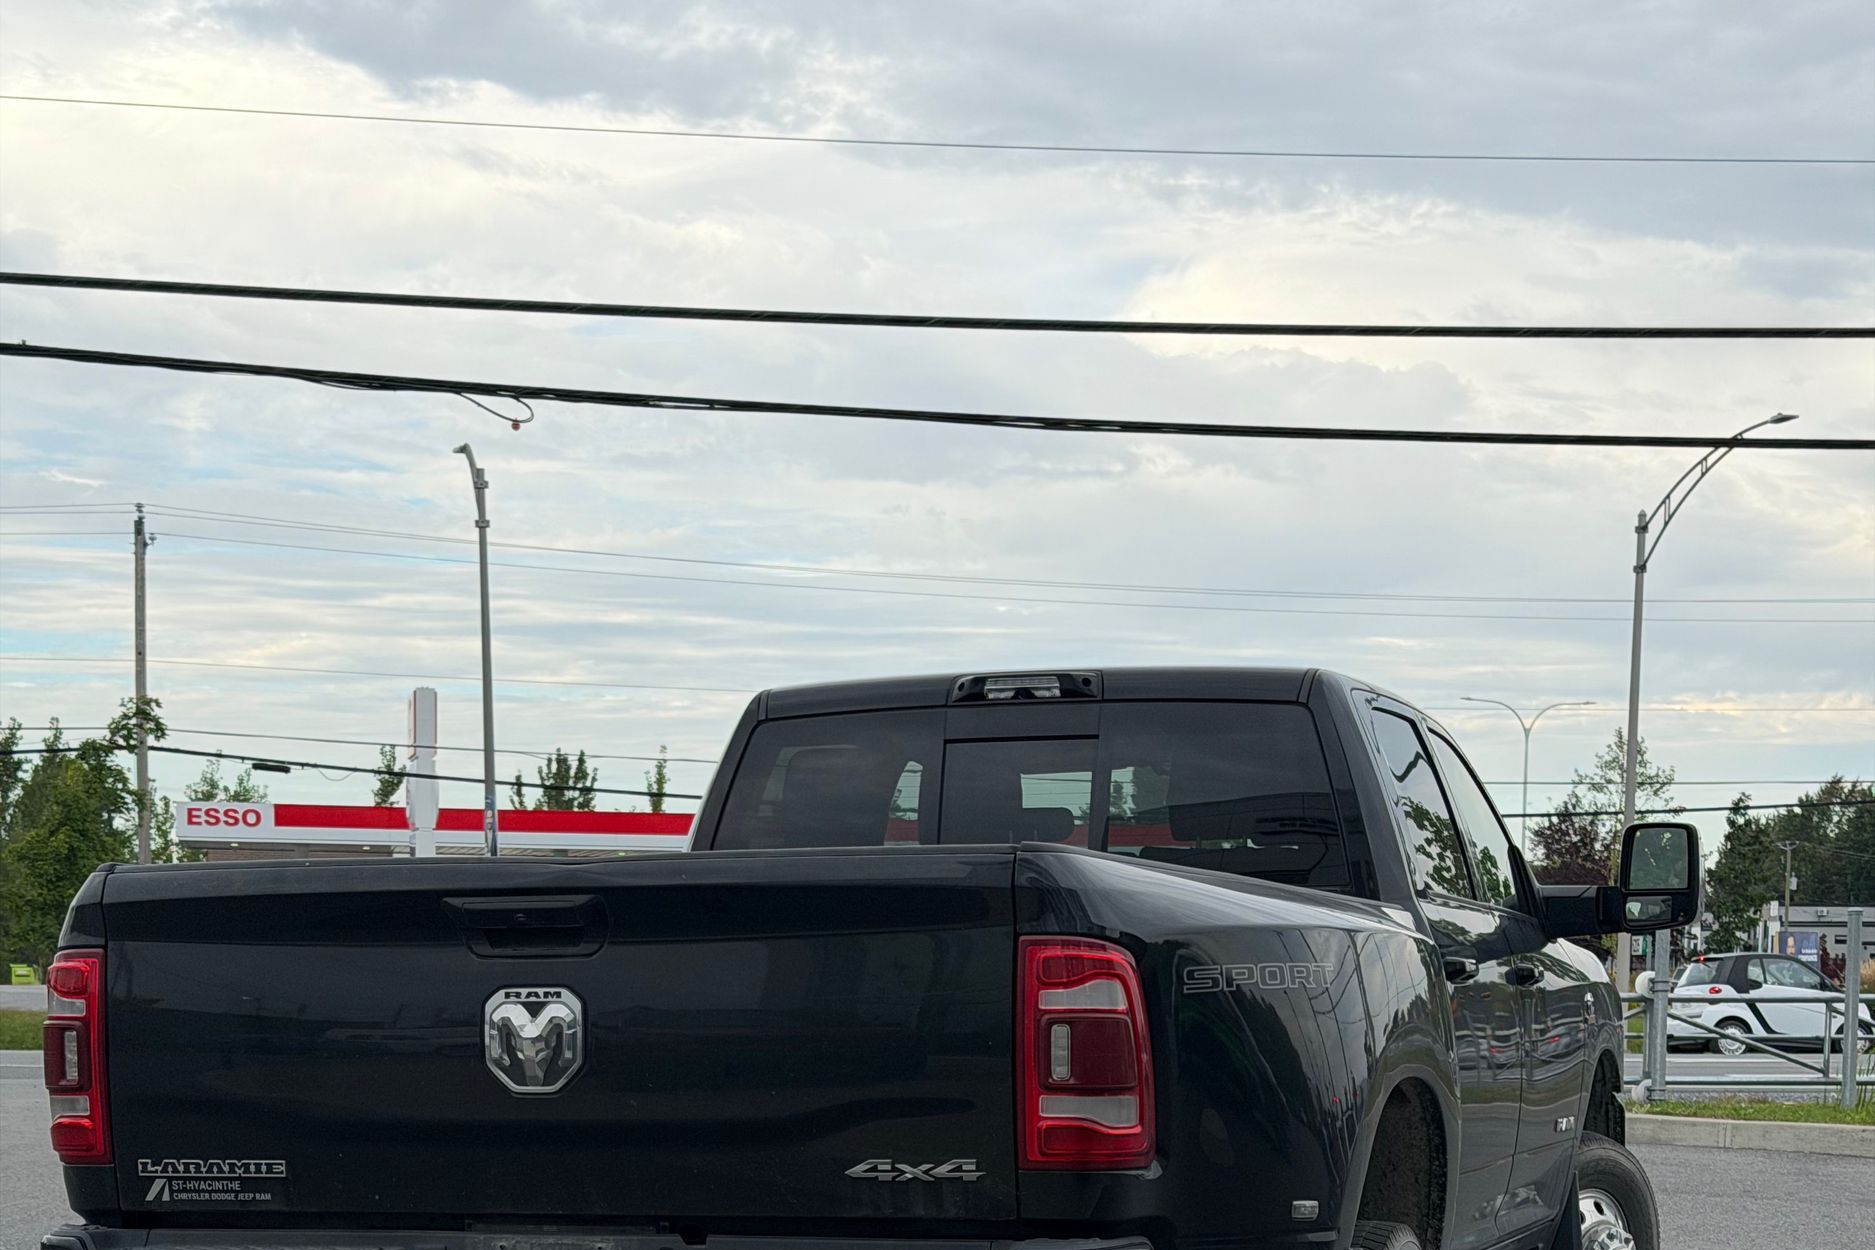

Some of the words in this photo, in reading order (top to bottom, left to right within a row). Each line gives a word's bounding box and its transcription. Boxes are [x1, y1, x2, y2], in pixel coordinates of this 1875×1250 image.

[186, 807, 262, 828] ESSO
[1183, 963, 1334, 994] SPORT
[504, 991, 562, 1000] RAM
[138, 1159, 286, 1177] LARAMIE
[171, 1180, 241, 1191] ST-HYACINTHE
[173, 1192, 210, 1201] CHRYSLER
[211, 1192, 235, 1201] DODGE
[237, 1192, 254, 1201] JEEP
[255, 1192, 272, 1201] RAM
